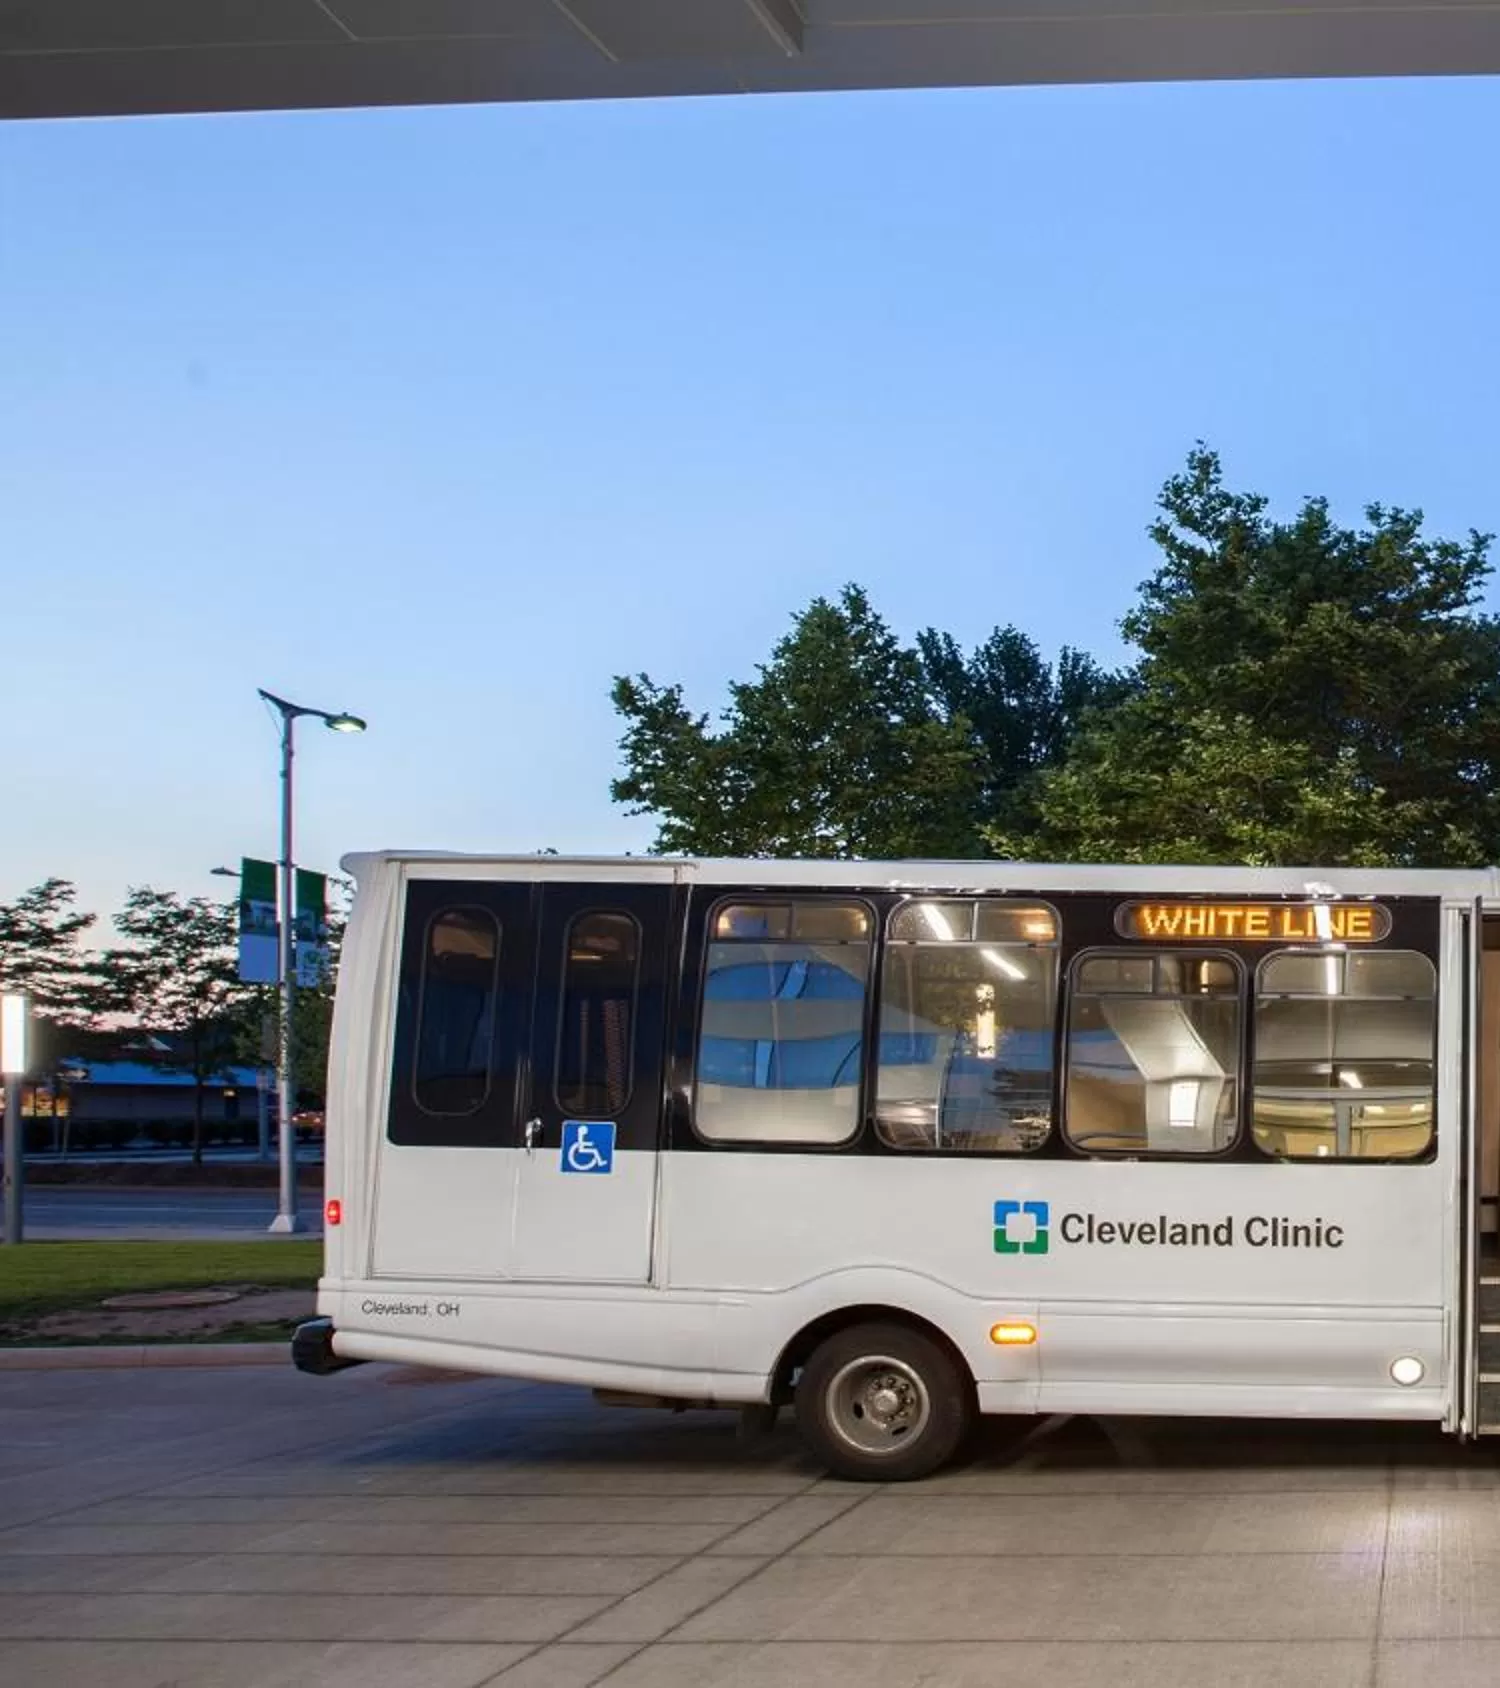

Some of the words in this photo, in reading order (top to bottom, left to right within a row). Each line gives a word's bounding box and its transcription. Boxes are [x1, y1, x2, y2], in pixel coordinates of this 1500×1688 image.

[1142, 906, 1270, 935] WHITE
[1283, 908, 1372, 936] LINE
[1060, 1213, 1233, 1246] Cleveland
[1244, 1216, 1344, 1249] Clinic
[437, 1302, 460, 1316] OH
